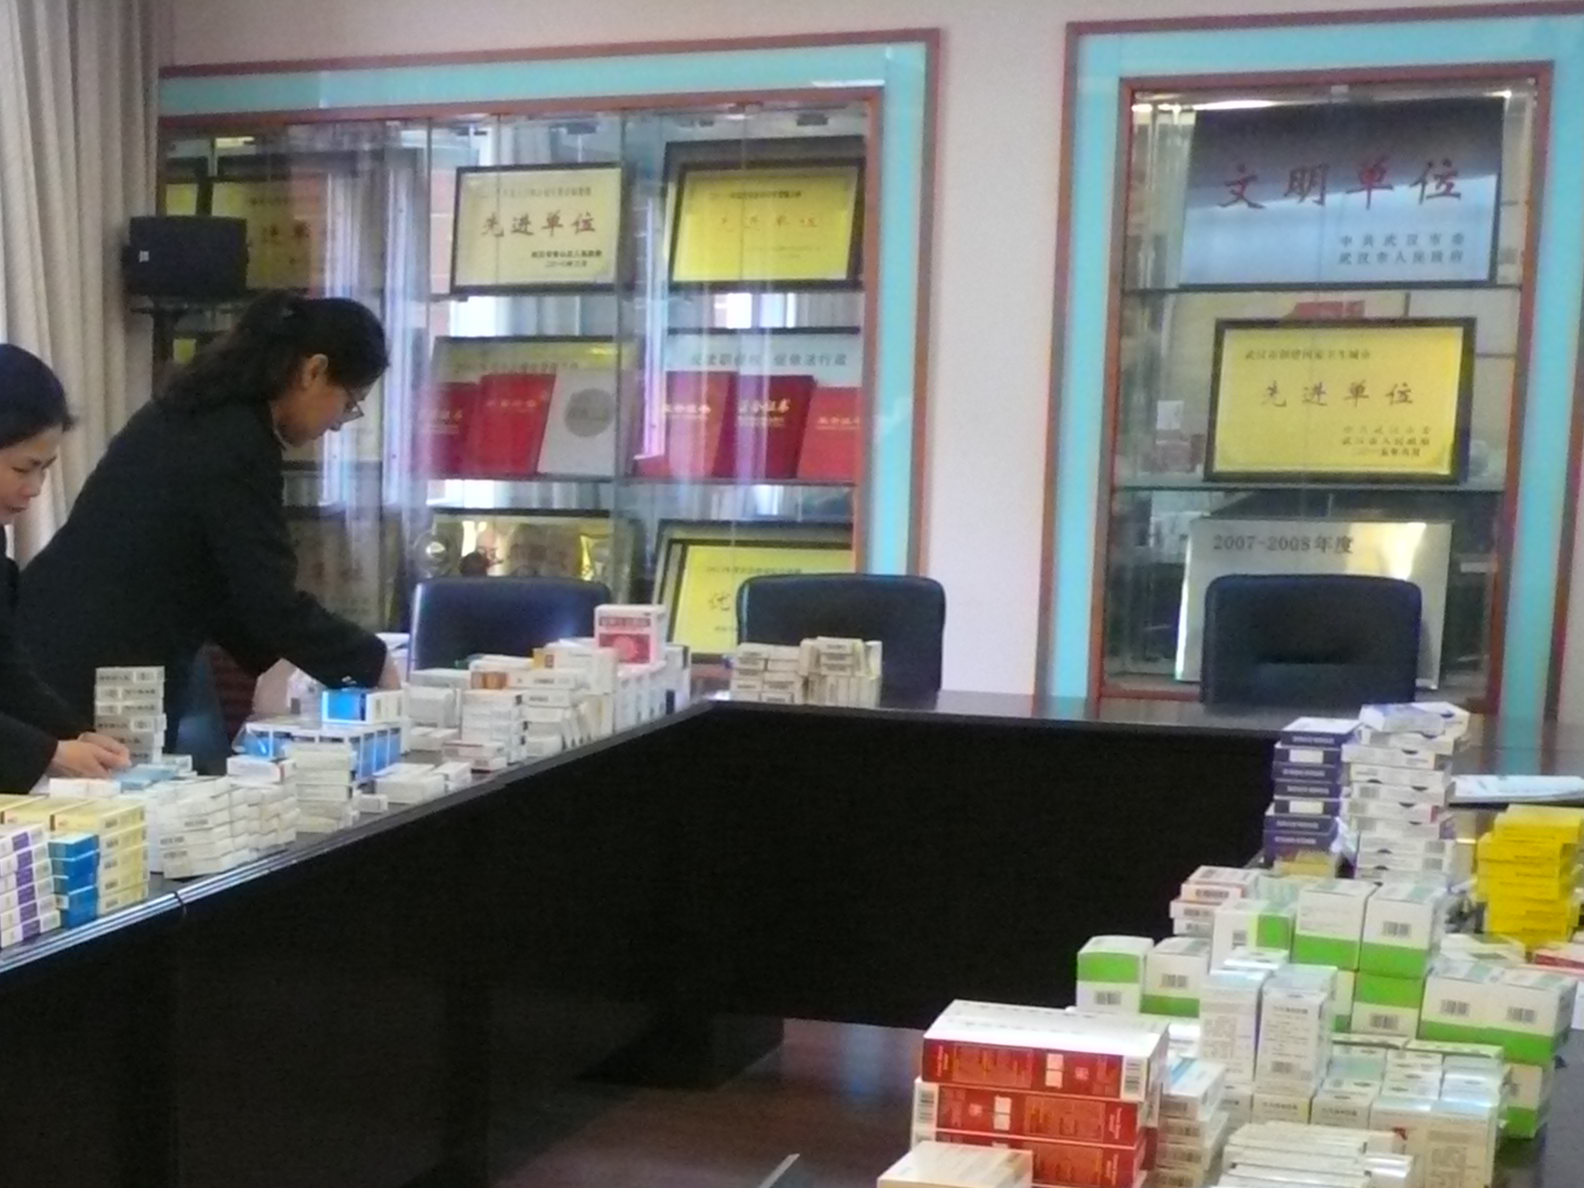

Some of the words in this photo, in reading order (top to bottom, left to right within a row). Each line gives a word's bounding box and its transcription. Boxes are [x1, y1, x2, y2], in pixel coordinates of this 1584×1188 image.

[1218, 158, 1462, 211] 文明单位
[481, 210, 596, 238] 先进单位
[1262, 380, 1413, 408] 先进单位
